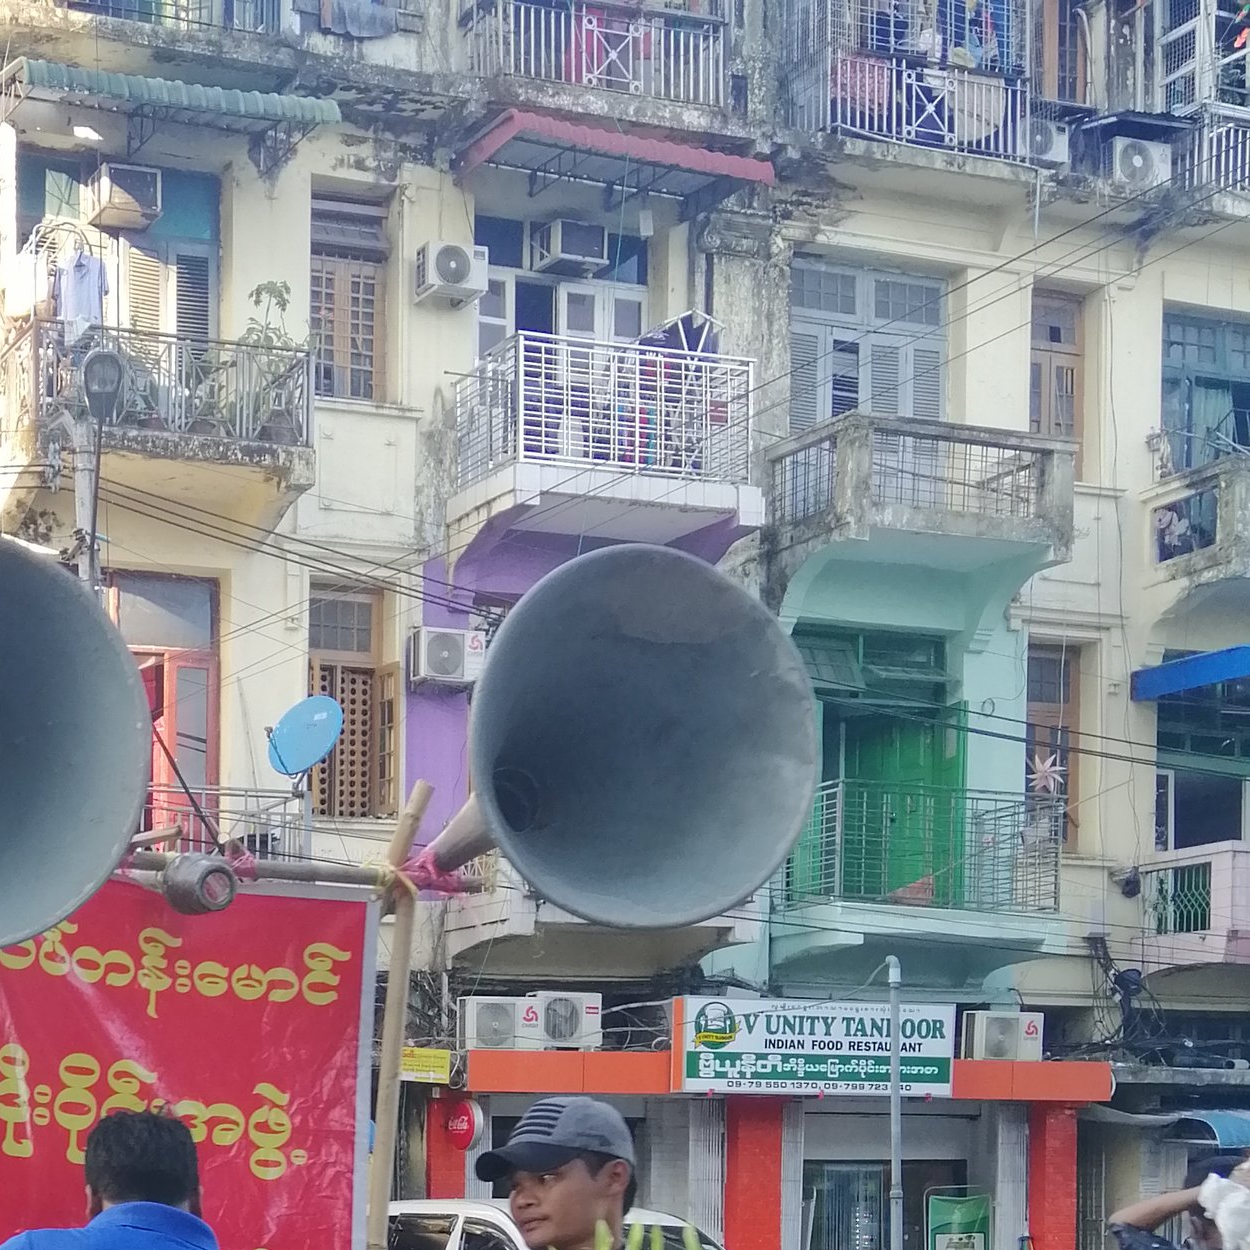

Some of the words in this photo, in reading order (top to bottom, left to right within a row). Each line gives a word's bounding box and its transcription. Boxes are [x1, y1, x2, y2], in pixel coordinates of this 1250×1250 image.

[741, 1013, 761, 1036] V
[765, 1013, 837, 1037] UNITY
[764, 1038, 805, 1050] INDIAN
[811, 1040, 843, 1051] FOOD
[848, 1041, 923, 1053] RESTAUANT
[765, 1081, 788, 1089] 550
